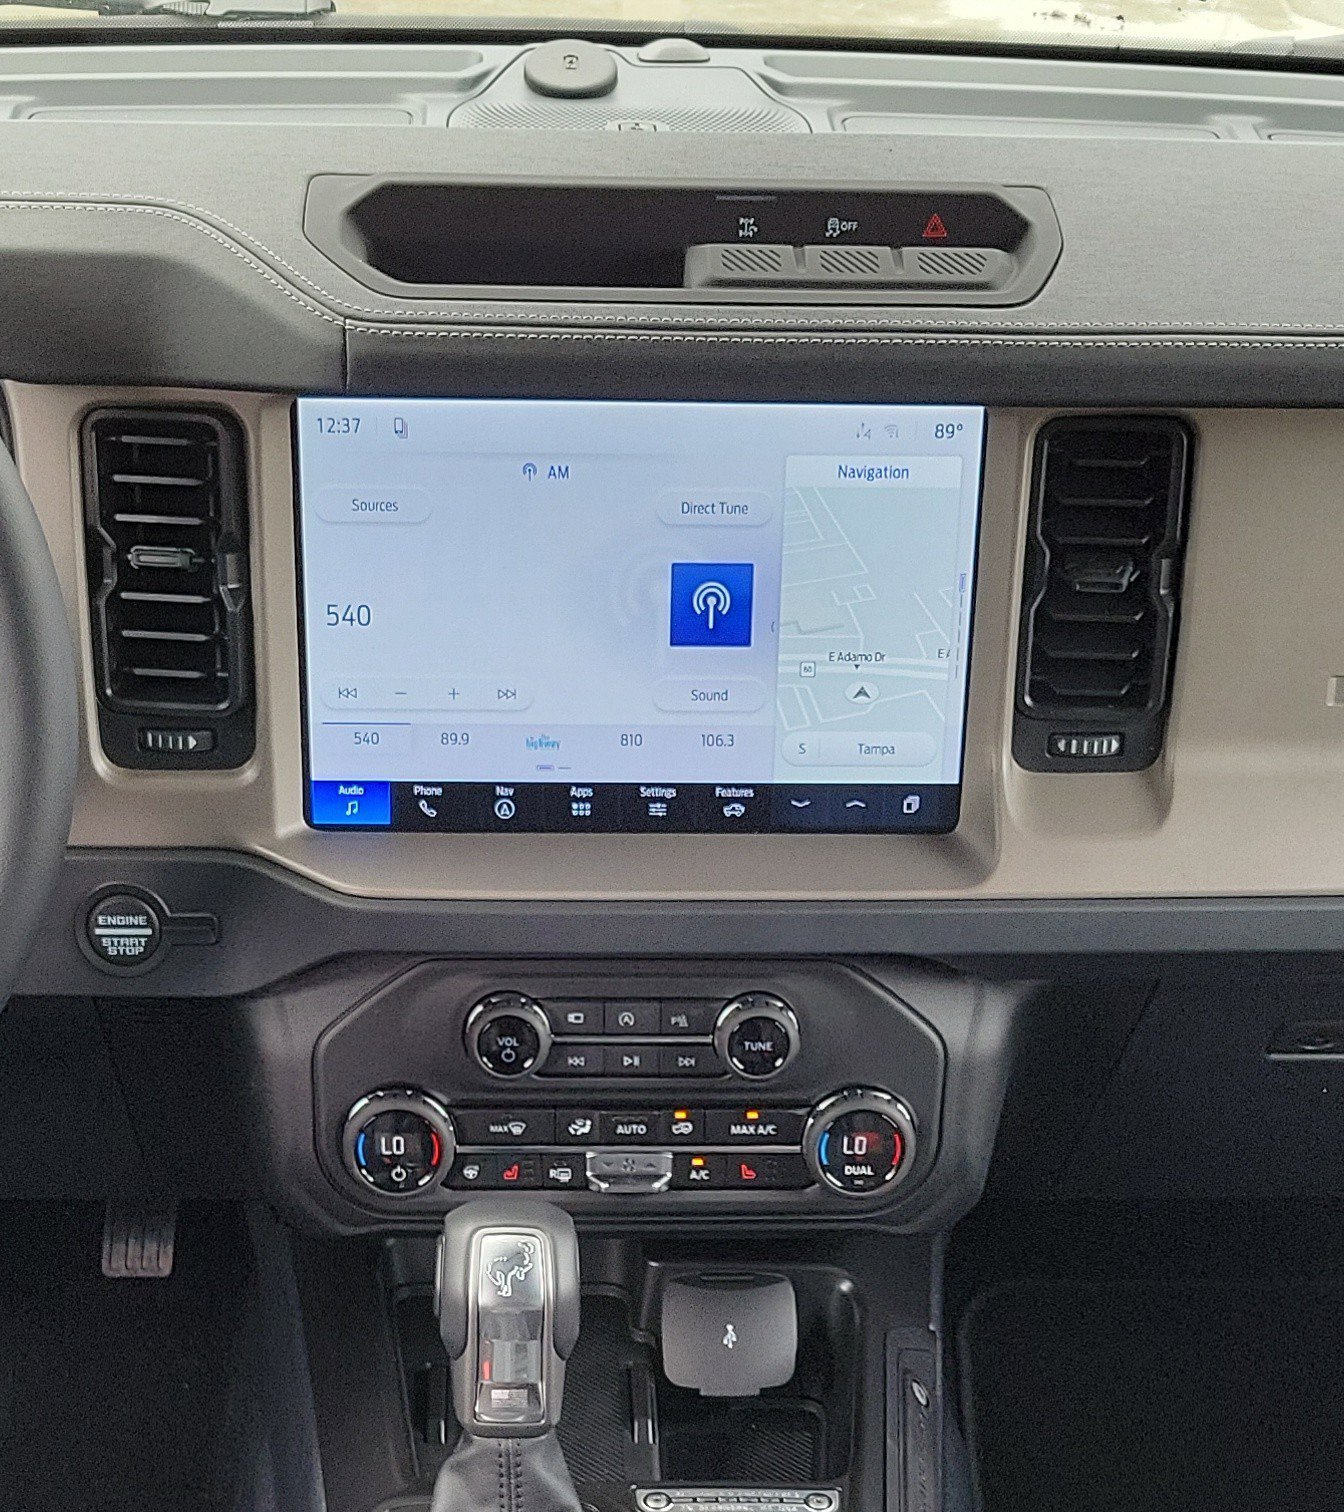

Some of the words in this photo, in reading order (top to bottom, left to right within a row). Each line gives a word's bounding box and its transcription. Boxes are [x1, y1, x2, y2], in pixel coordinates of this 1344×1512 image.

[841, 221, 858, 232] OFF
[317, 417, 361, 434] 12:37
[547, 465, 570, 480] AM
[837, 464, 910, 482] Navigation
[352, 498, 399, 512] Sources
[681, 501, 716, 515] Direct
[719, 501, 749, 515] Tune
[326, 604, 372, 627] 540
[829, 652, 836, 662] E
[837, 652, 873, 662] Adamo
[875, 652, 886, 662] Dr
[691, 689, 729, 701] Sound
[353, 732, 380, 745] 540
[440, 732, 470, 746] 89.9
[620, 733, 643, 747] 810
[701, 733, 735, 747] 106.3
[798, 743, 806, 755] S
[858, 743, 895, 756] Tampa
[338, 785, 364, 796] Audio
[413, 785, 443, 797] Phone
[495, 786, 514, 797] Nav
[570, 786, 594, 799] Apps
[639, 786, 677, 799] Settings
[715, 786, 755, 798] Features
[98, 915, 148, 926] ENGINE
[102, 937, 148, 947] START
[107, 946, 145, 956] STOP
[497, 1036, 519, 1047] VOL
[744, 1040, 774, 1052] TUNE
[489, 1124, 508, 1133] MAX
[616, 1124, 647, 1135] AUTO
[730, 1124, 756, 1135] MAX
[757, 1124, 777, 1135] A/C
[381, 1136, 405, 1156] LO
[843, 1136, 867, 1156] LO
[689, 1169, 710, 1181] A/C
[844, 1165, 875, 1176] DUAL
